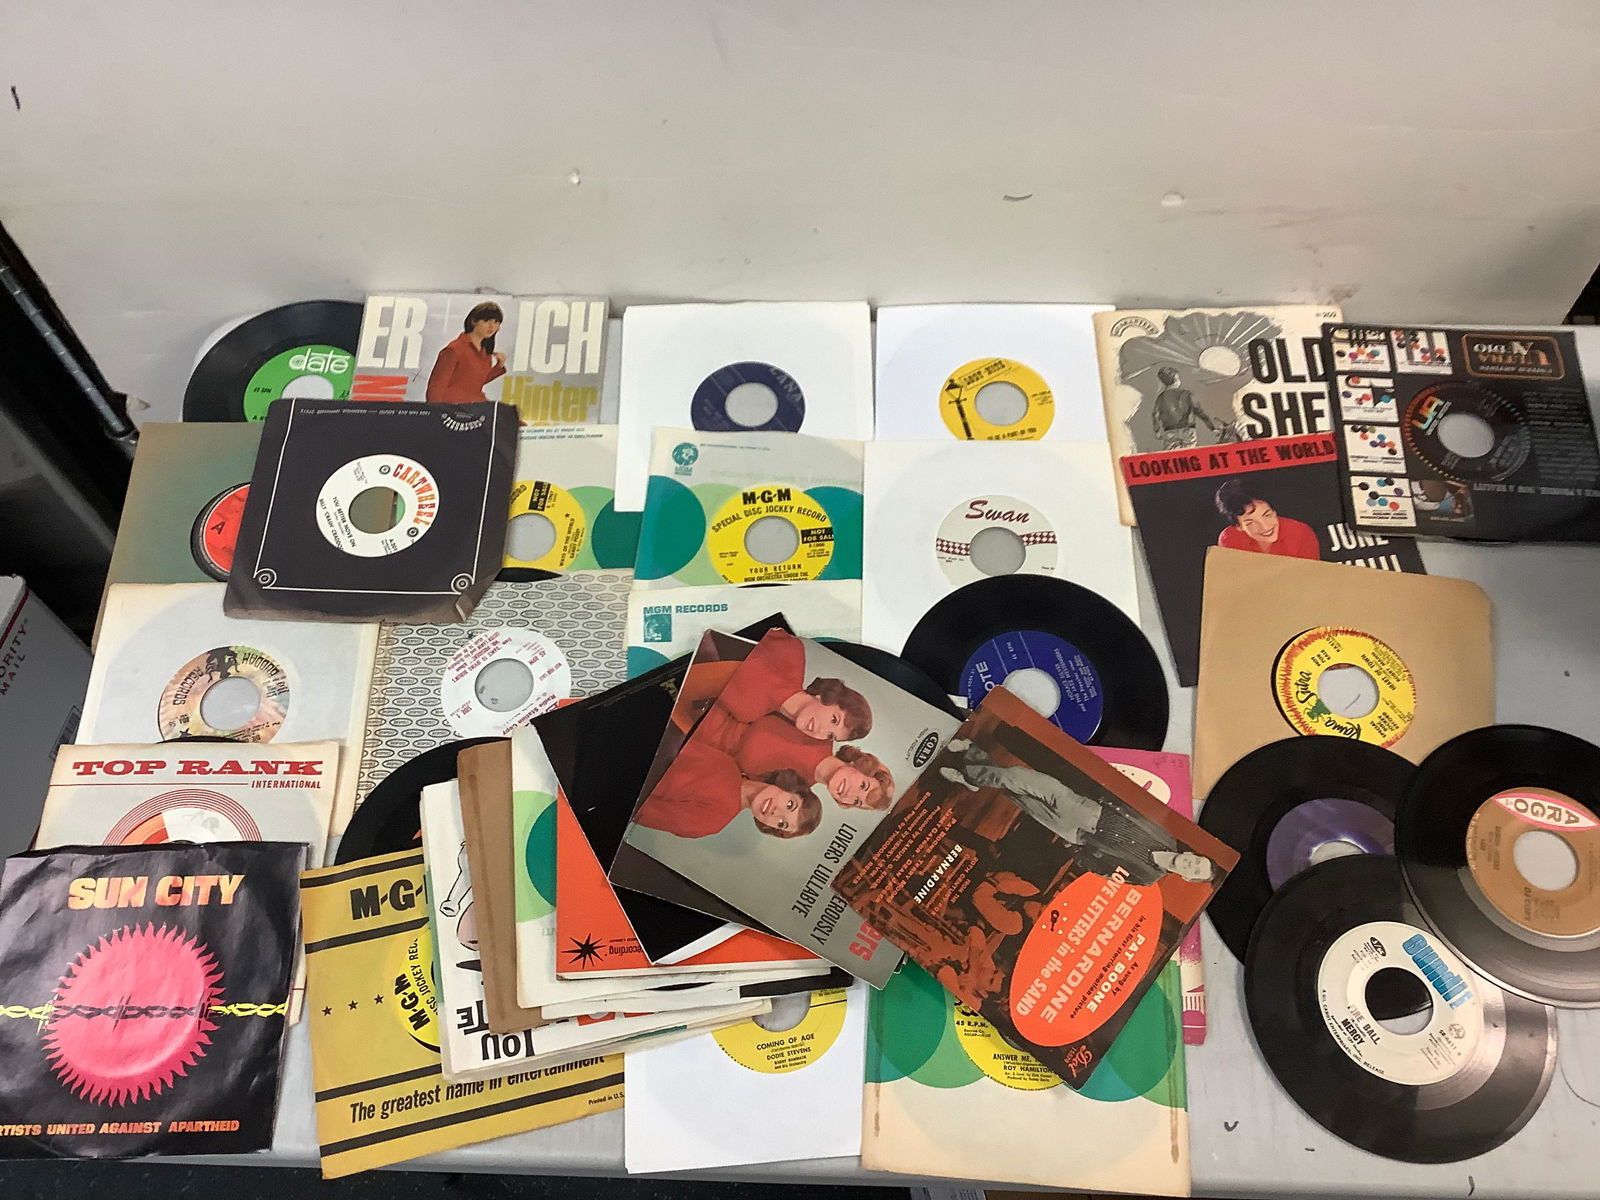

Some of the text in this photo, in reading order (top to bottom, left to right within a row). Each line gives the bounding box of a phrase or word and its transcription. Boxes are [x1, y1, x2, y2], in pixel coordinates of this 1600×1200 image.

[357, 295, 428, 369] ER
[513, 300, 605, 374] ICH
[289, 348, 350, 374] date
[1248, 337, 1327, 384] OLD
[1241, 392, 1326, 438] SHE
[1129, 455, 1202, 478] LOOKING
[1209, 452, 1229, 470] AT
[1235, 447, 1271, 468] THE
[1275, 439, 1335, 462] WORLD
[392, 463, 436, 526] CARTWHEEL
[712, 505, 828, 534] SPECIAL DISC JOCKEY RECORD
[965, 500, 1030, 523] Swan
[211, 521, 226, 535] A
[643, 603, 729, 614] MGM RECORDS
[0, 654, 26, 695] MAIL
[975, 660, 997, 692] OTE
[1359, 653, 1376, 669] TOWN
[1379, 674, 1398, 691] HEART
[516, 706, 539, 725] Station
[538, 693, 556, 708] Radio
[1295, 671, 1361, 740] Kama Sutra
[1368, 720, 1388, 739] SPECIAL
[916, 735, 938, 766] CORAL
[72, 760, 323, 776] TOP RANK
[251, 780, 322, 789] INTERNATIONAL
[943, 817, 957, 832] PAT
[1514, 798, 1580, 825] ARGO
[791, 822, 857, 919] LOVERS LULLABYE
[913, 843, 963, 905] BERNARDINE
[67, 875, 245, 910] SUN CITY
[350, 878, 428, 920] M-G-
[808, 892, 849, 946] EROUSLY
[1012, 865, 1131, 1018] LOVE LETTERS in the SAND
[1035, 887, 1148, 1024] BERNARDINE
[408, 938, 431, 996] JOCKEY REC
[1066, 915, 1146, 1020] in his first starring motion picture
[1084, 933, 1147, 1013] PAT BOONE
[1111, 961, 1139, 997] As sung by
[756, 1039, 785, 1051] COMING
[801, 1033, 815, 1041] AGE
[1340, 1017, 1365, 1047] MERCY
[1362, 1023, 1381, 1046] BALL
[766, 1051, 784, 1061] DODIE
[787, 1047, 811, 1056] STEVENS
[992, 1053, 1018, 1061] ANSWER
[350, 1102, 375, 1123] The
[381, 1084, 441, 1119] greatest
[445, 1080, 484, 1101] name
[588, 1095, 607, 1105] Printed
[46, 1123, 96, 1136] UNITED
[99, 1121, 162, 1135] AGAINST
[167, 1120, 240, 1133] APARTHEID
